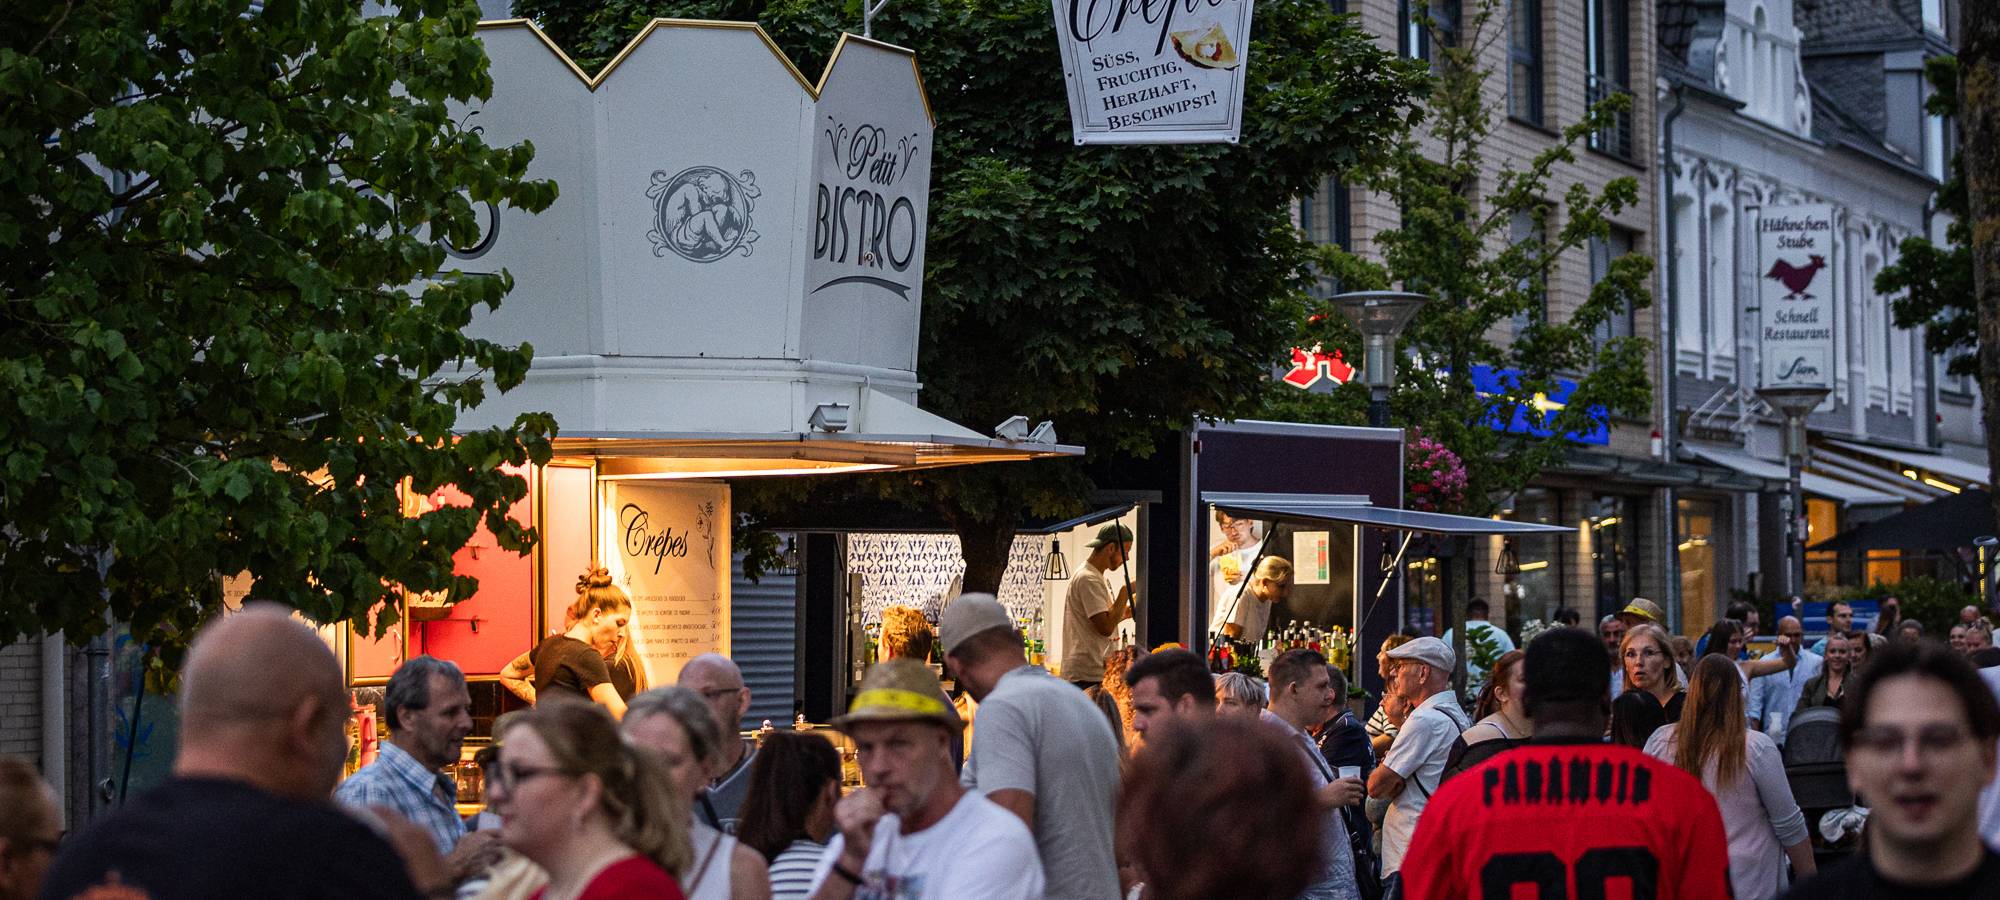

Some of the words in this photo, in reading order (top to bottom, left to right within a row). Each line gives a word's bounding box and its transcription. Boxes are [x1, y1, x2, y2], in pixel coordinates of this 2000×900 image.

[1092, 51, 1140, 72] SÜSS,
[1096, 61, 1183, 91] FRUCHTIG,
[1101, 78, 1197, 112] HERZHAFT,
[1106, 90, 1218, 130] BESCHWIPST!
[847, 124, 898, 185] Petit
[814, 183, 917, 272] BISTRO
[1776, 234, 1815, 249] Stube
[1774, 306, 1819, 325] Schnell
[1763, 325, 1830, 341] Restaurant
[620, 503, 689, 575] Crêpes
[1483, 755, 1652, 807] PARANOID
